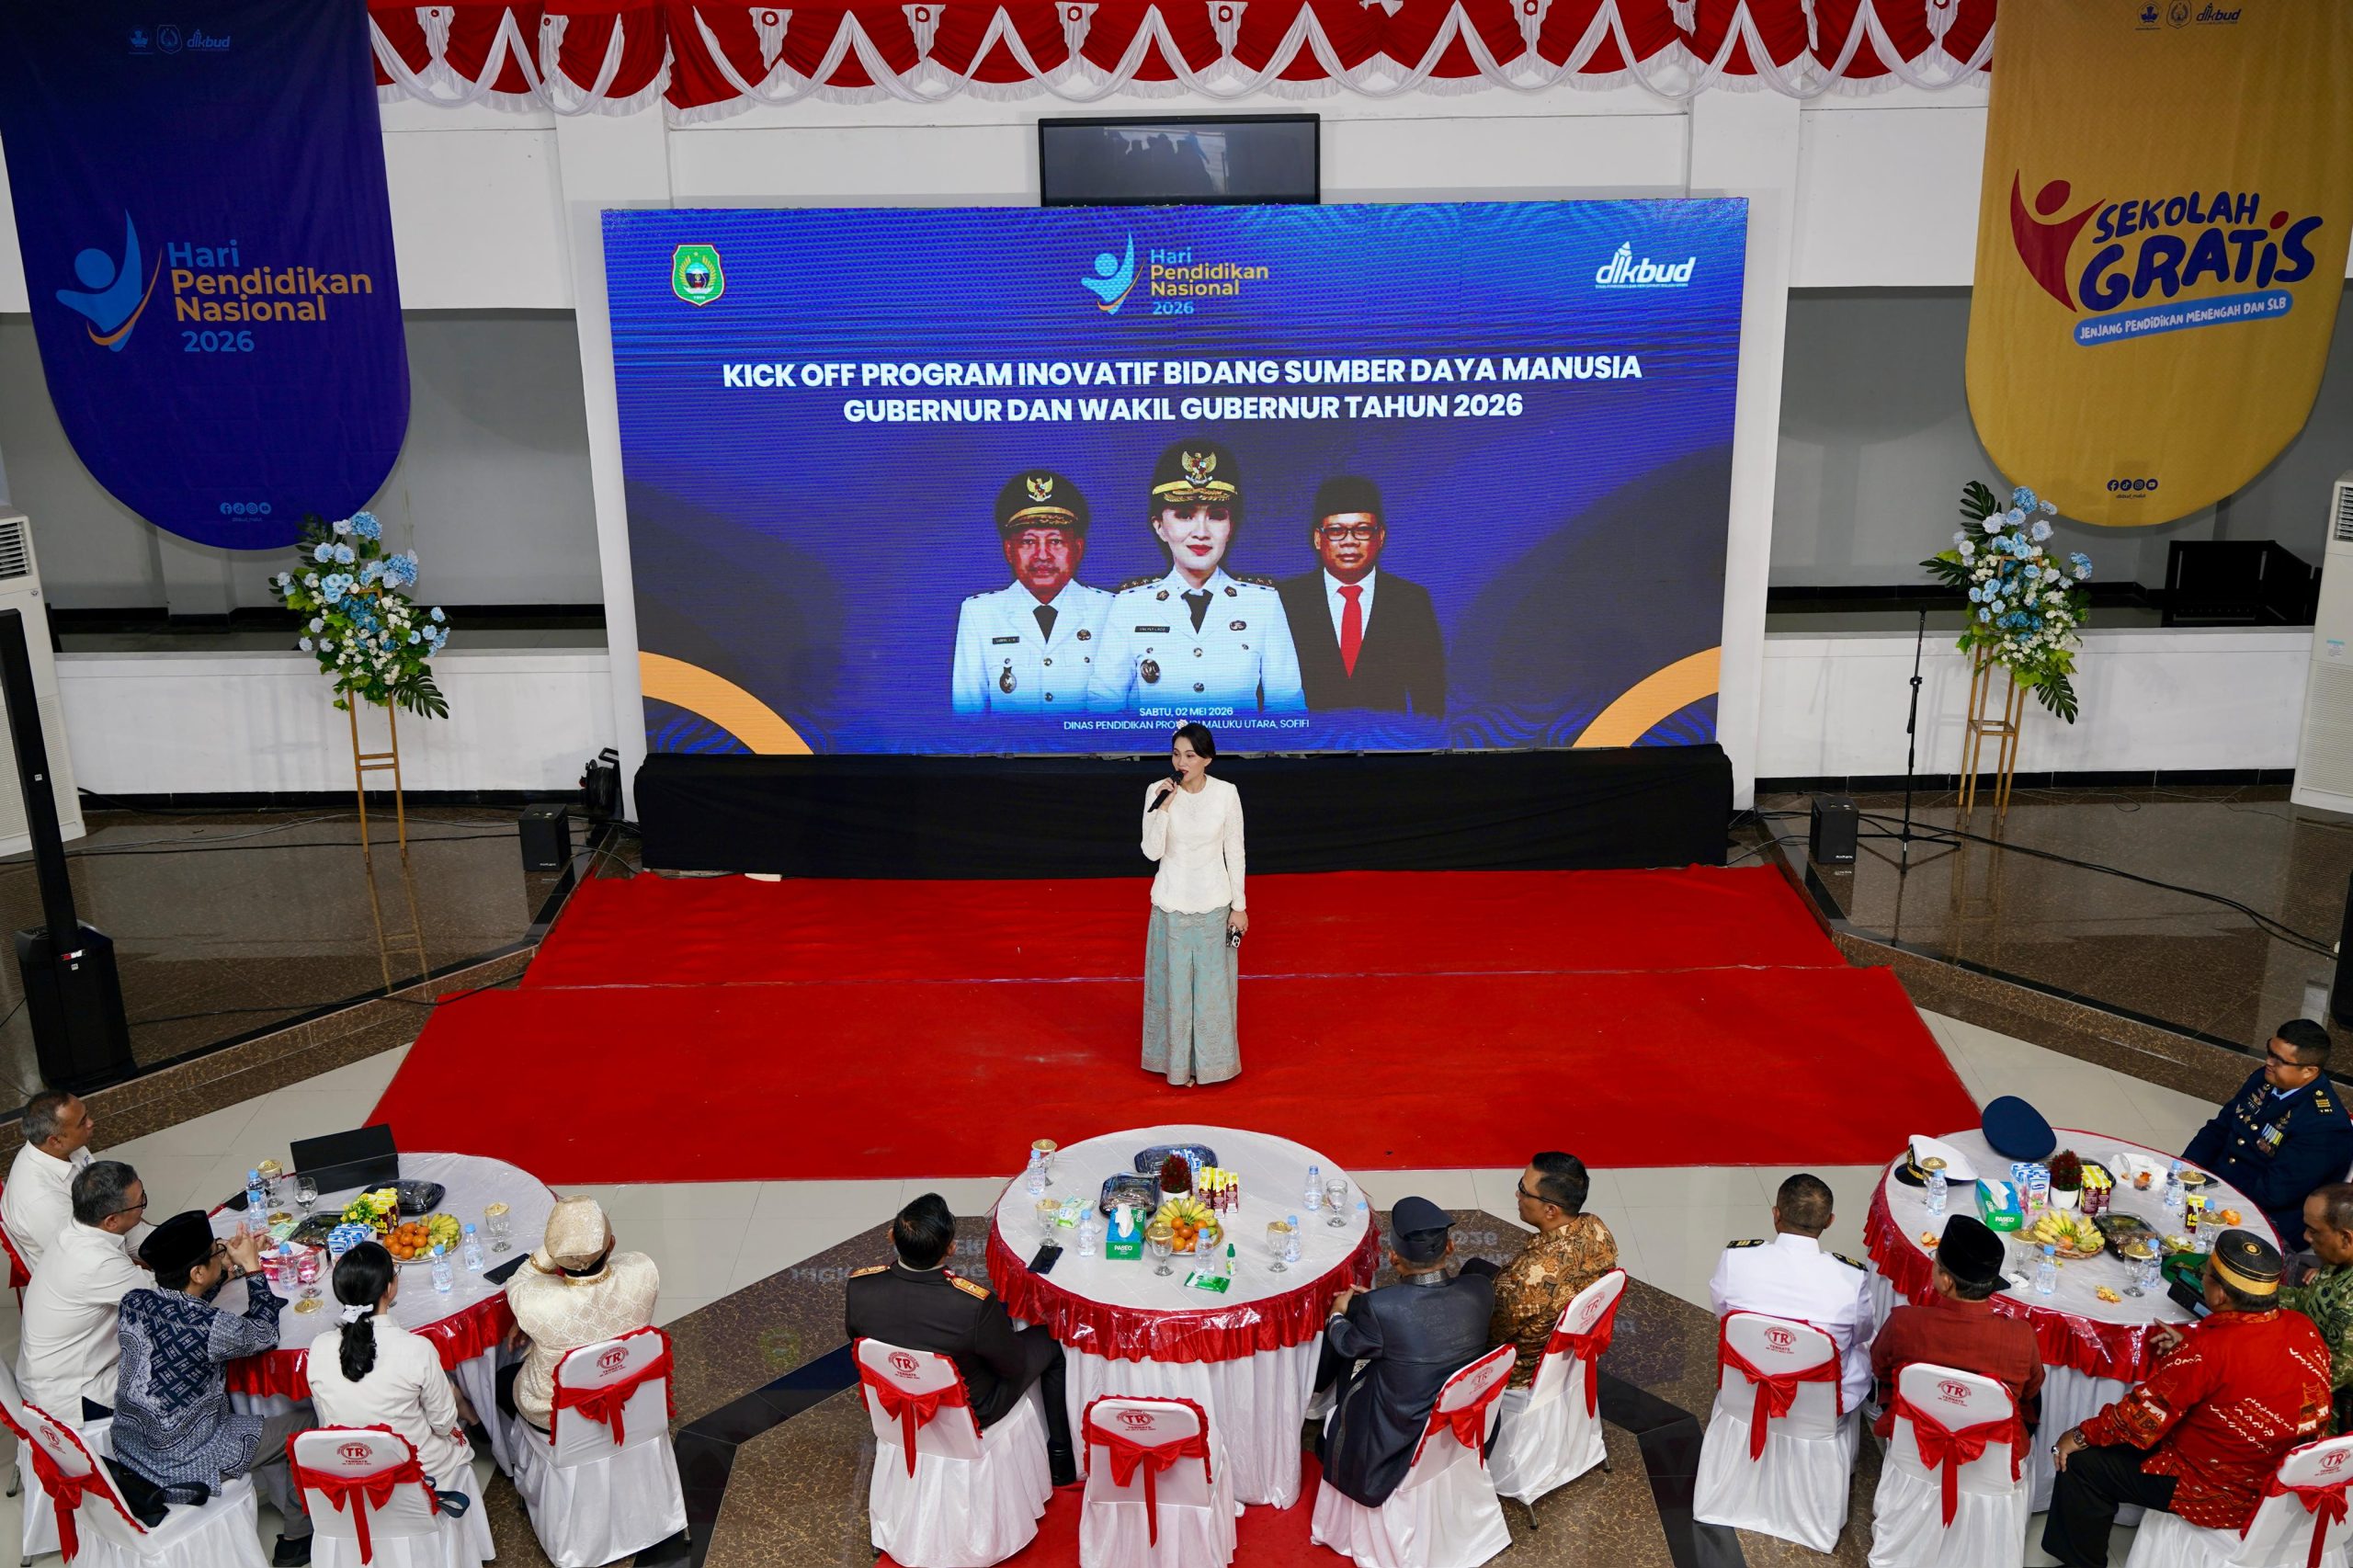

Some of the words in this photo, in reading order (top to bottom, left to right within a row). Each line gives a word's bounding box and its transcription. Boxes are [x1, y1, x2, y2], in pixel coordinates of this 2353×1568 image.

[2093, 191, 2260, 244] SEKOLAH
[167, 239, 240, 268] Hari
[1151, 246, 1191, 264] Hari
[1151, 262, 1268, 279] Pendidikan
[172, 267, 373, 296] Pendidikan
[1151, 278, 1240, 296] Nasional
[176, 294, 327, 323] Nasional
[1153, 301, 1194, 314] 2026
[2080, 323, 2122, 340] JENJANG
[2186, 305, 2241, 323] MENENGAH
[2244, 300, 2265, 315] DAN
[2267, 297, 2287, 311] SLB
[183, 329, 256, 353] 2026
[724, 364, 795, 387] KICK
[801, 363, 856, 387] OFF
[862, 363, 1012, 386] PROGRAM
[1018, 361, 1158, 385] INOVATIF
[1165, 360, 1279, 384] BIDANG
[1284, 358, 1405, 383] SUMBER
[1412, 358, 1496, 382] DAYA
[1503, 356, 1643, 381] MANUSIA
[844, 399, 1002, 422] GUBERNUR
[1008, 399, 1073, 421] DAN
[1078, 398, 1176, 421] WAKIL
[1181, 396, 1340, 420] GUBERNUR
[1345, 395, 1448, 418] TAHUN
[1453, 393, 1524, 417] 2026
[1140, 707, 1174, 717] SABTU,
[1176, 707, 1188, 716] 02
[1189, 707, 1207, 716] MEI
[1209, 706, 1233, 716] 2026
[1064, 721, 1094, 730] DINAS
[1096, 721, 1154, 730] PENDIDIKAN
[1202, 720, 1242, 729] MALUKU
[1245, 720, 1279, 730] UTARA,
[1280, 719, 1310, 728] SOFIFI
[1772, 1332, 1789, 1344] TR
[606, 1352, 621, 1366] TR
[895, 1358, 912, 1369] TR
[1947, 1384, 1963, 1396] TR
[347, 1448, 364, 1457] TR
[2328, 1453, 2344, 1466] TR
